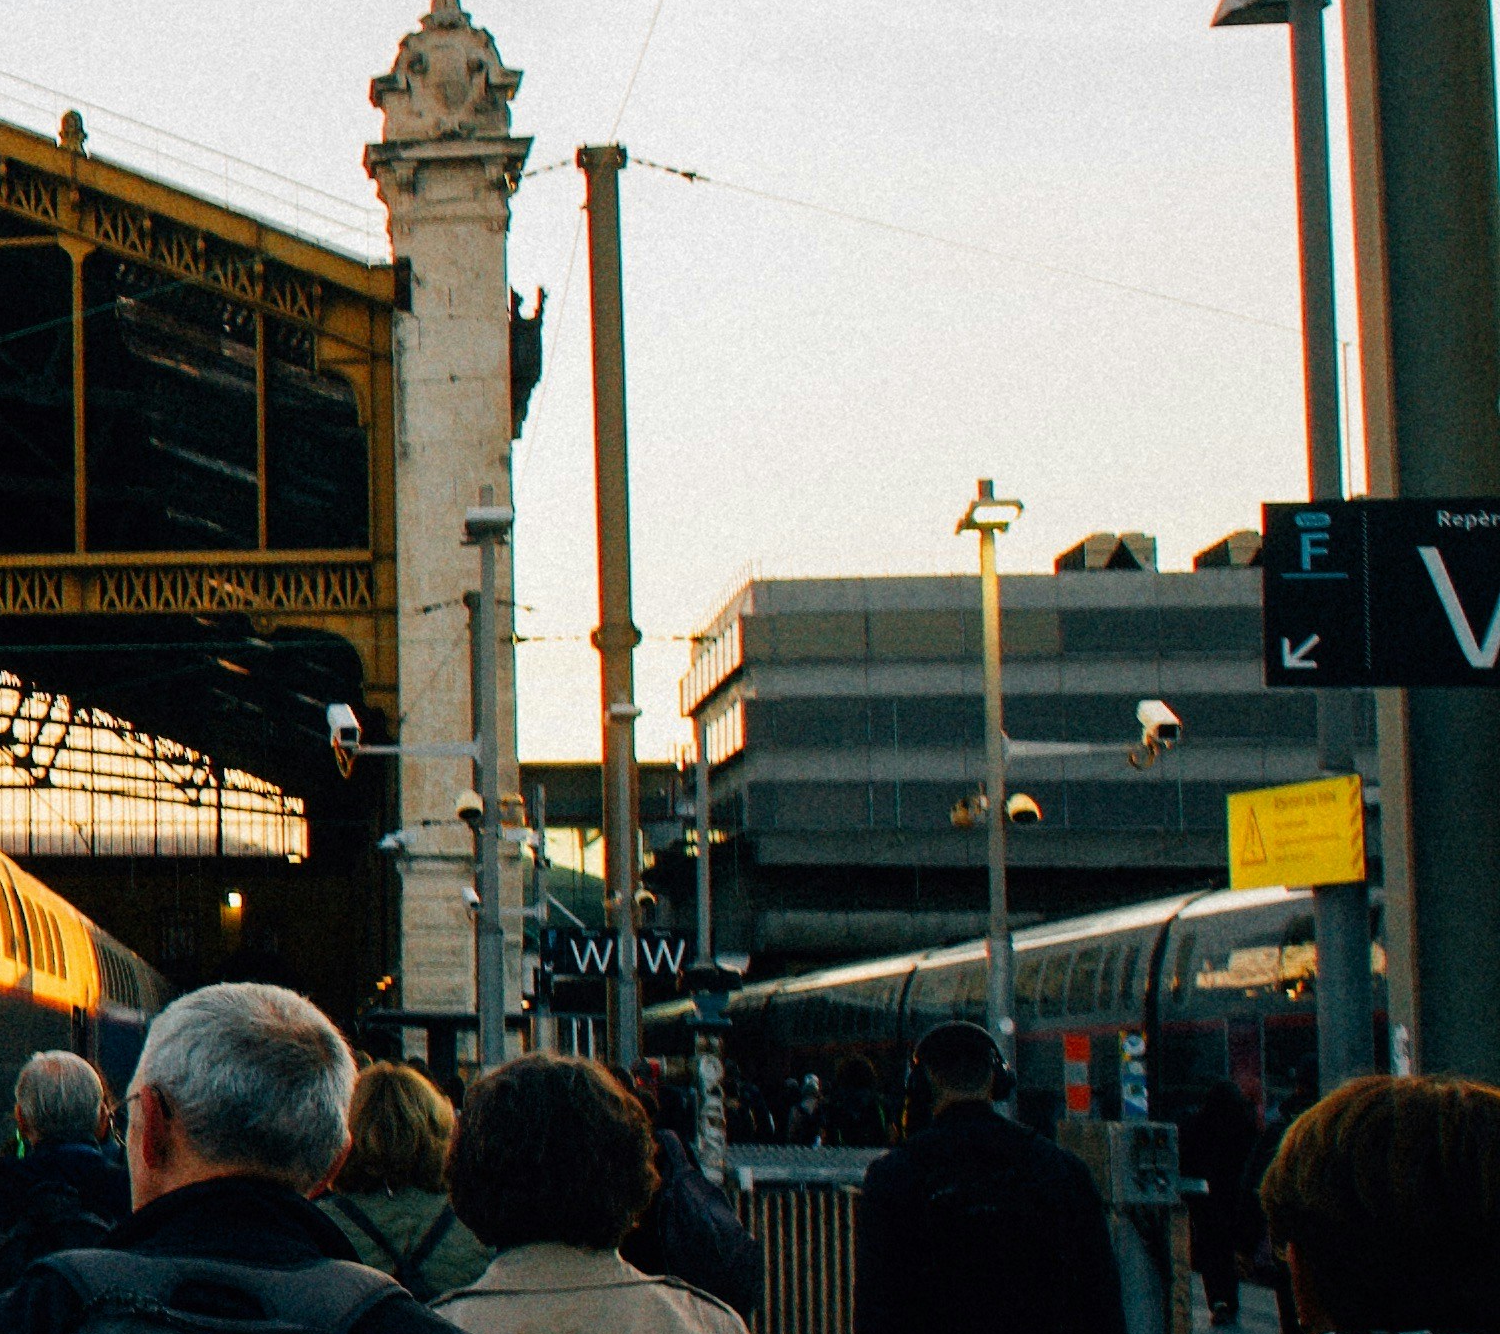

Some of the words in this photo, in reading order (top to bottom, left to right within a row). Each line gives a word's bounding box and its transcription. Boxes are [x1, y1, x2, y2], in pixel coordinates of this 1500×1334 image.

[1301, 532, 1330, 571] F
[569, 937, 614, 974] W
[640, 937, 686, 975] W
